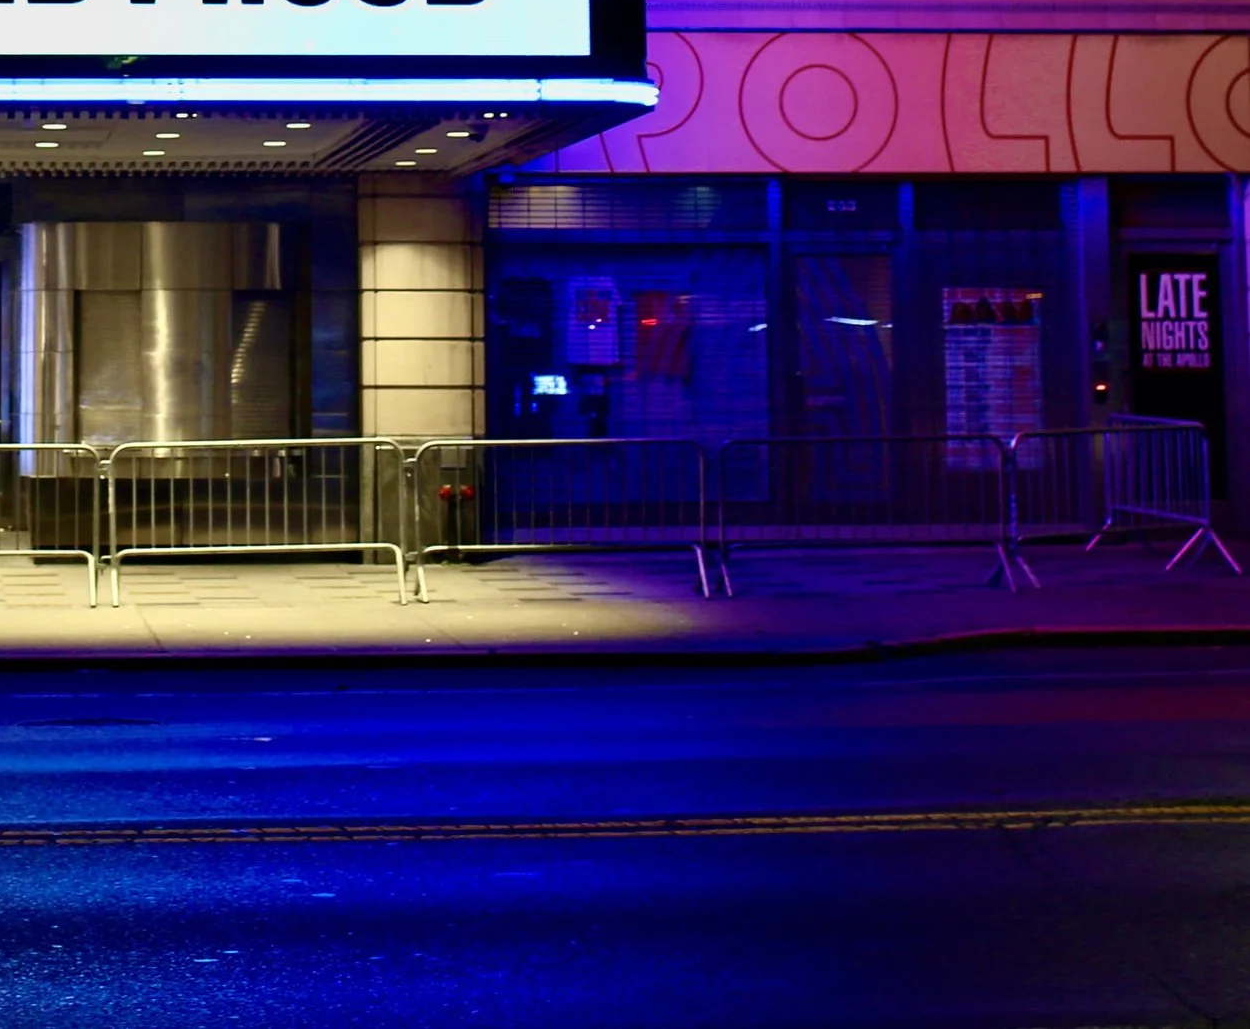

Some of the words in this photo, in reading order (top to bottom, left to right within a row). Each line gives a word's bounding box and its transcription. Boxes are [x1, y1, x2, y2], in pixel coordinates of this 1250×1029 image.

[554, 32, 1250, 173] POLL
[1139, 273, 1209, 319] LATE
[1141, 321, 1209, 351] NIGHTS
